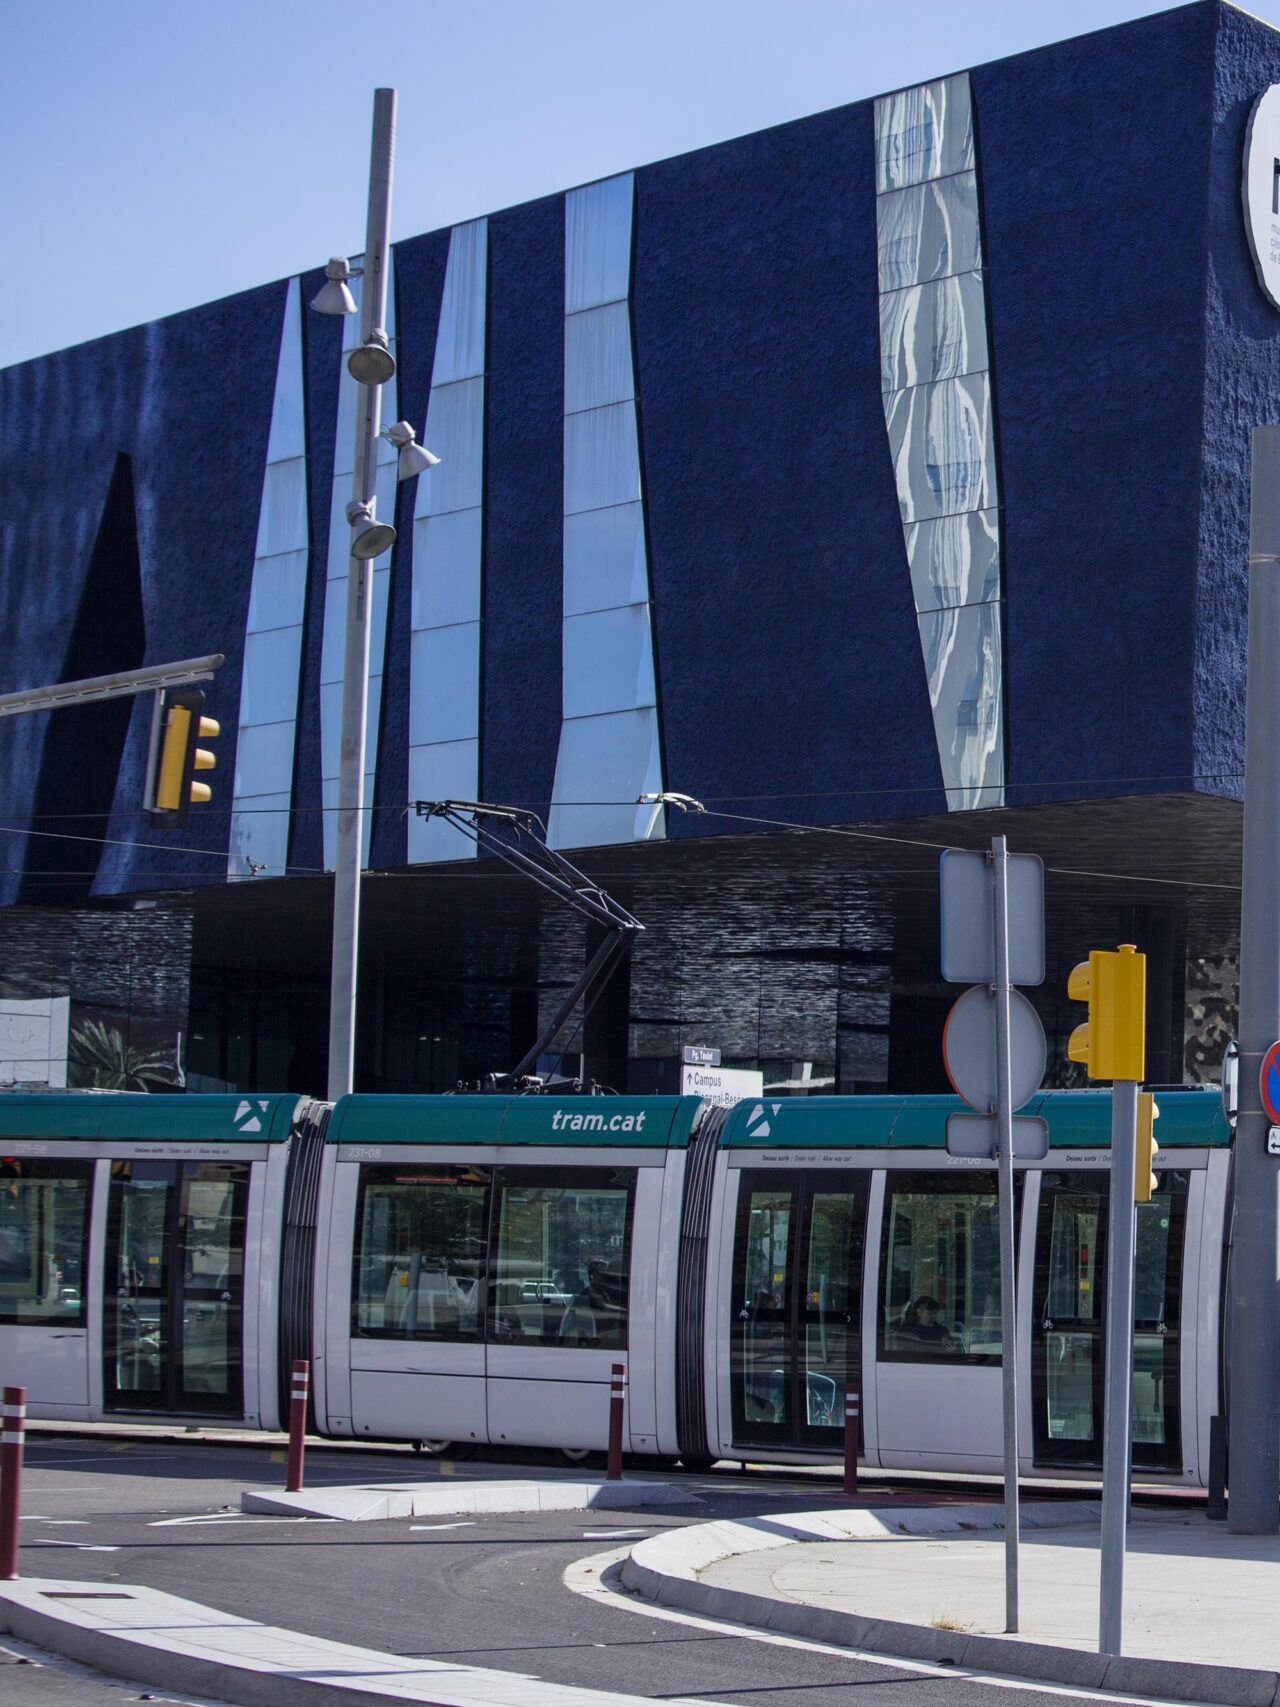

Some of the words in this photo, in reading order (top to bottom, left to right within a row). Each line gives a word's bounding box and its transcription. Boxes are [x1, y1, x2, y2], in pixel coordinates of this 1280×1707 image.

[694, 1072, 722, 1089] Campus
[551, 1109, 646, 1132] tram.cat
[348, 1147, 381, 1160] 231-08
